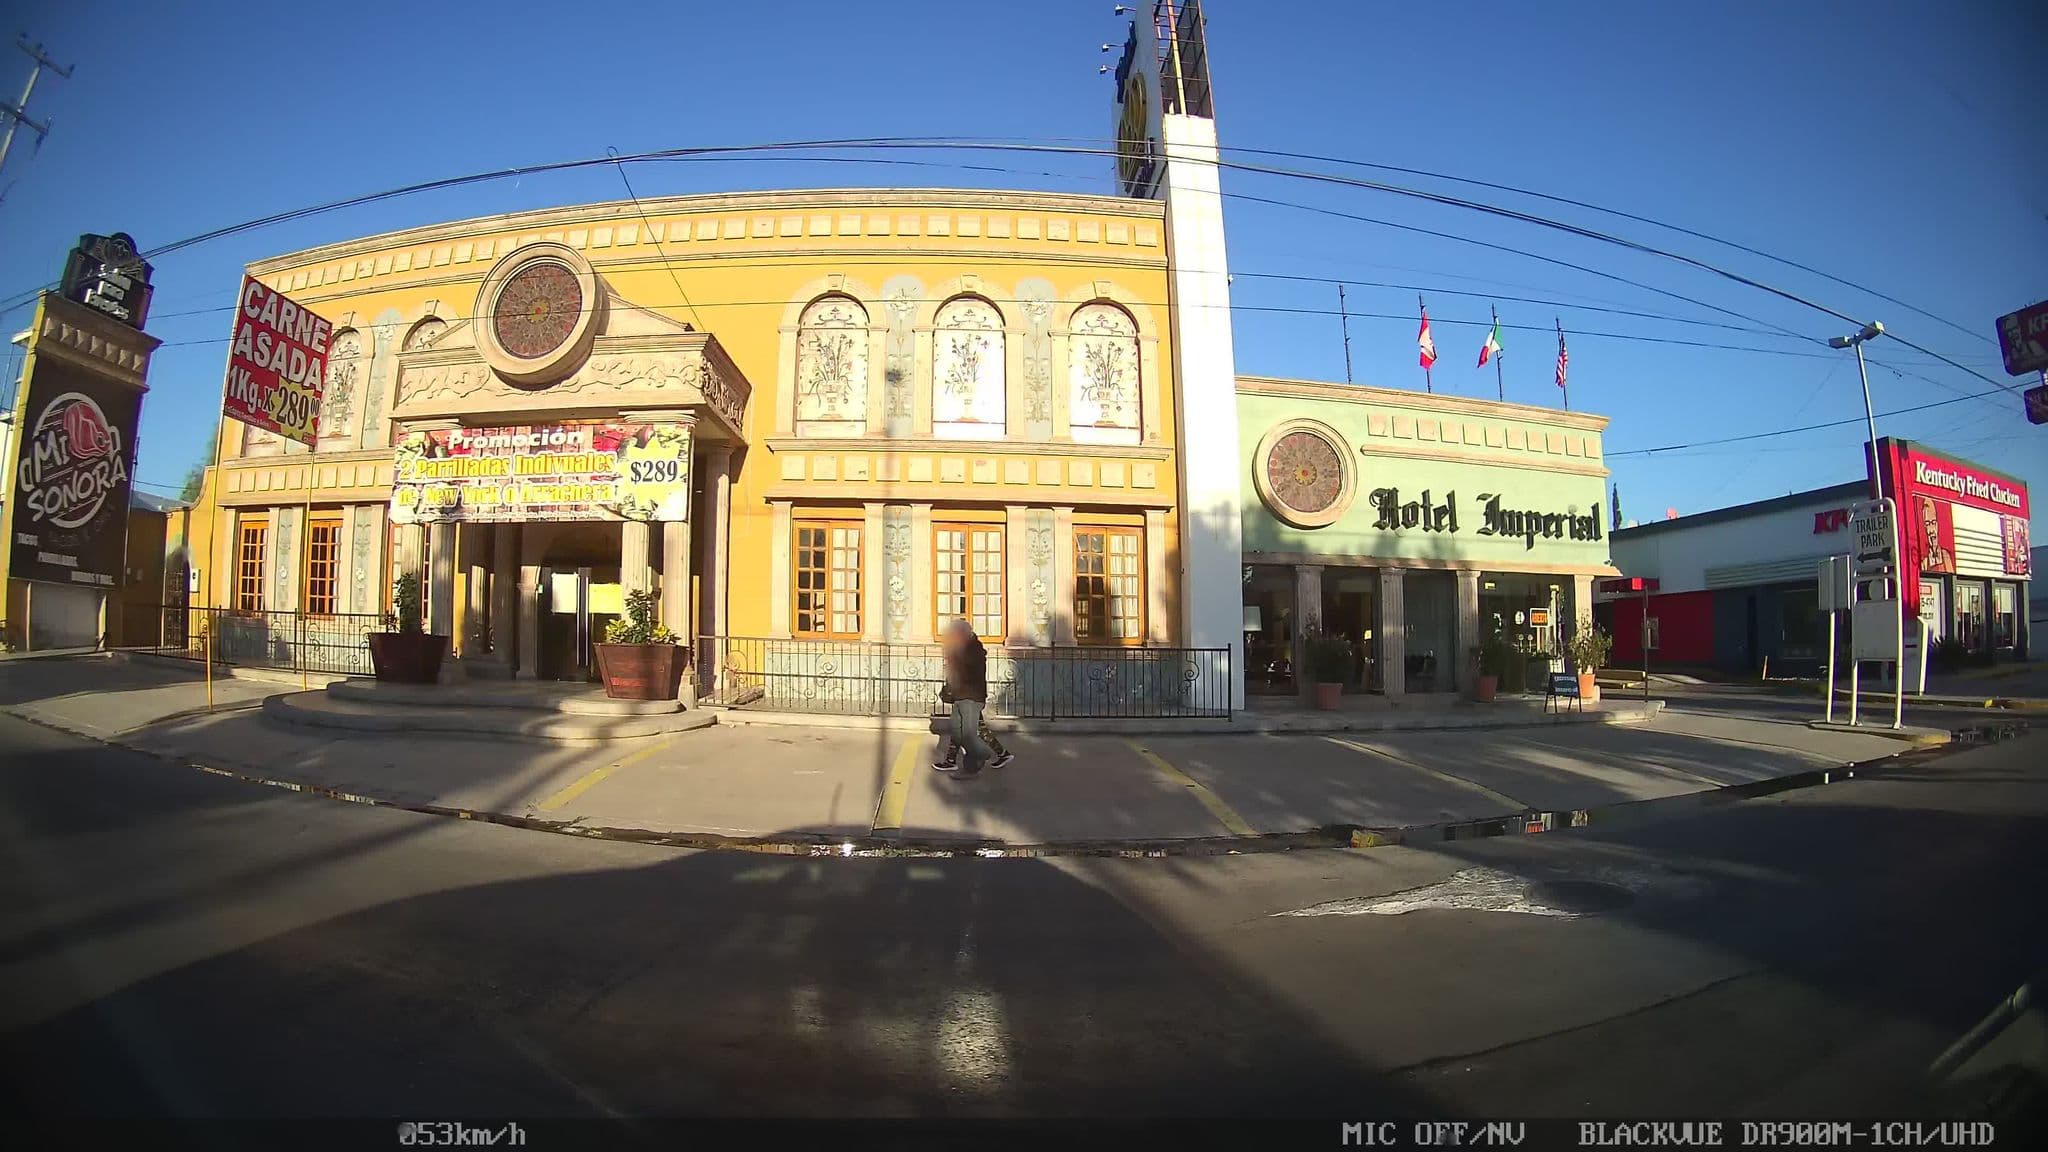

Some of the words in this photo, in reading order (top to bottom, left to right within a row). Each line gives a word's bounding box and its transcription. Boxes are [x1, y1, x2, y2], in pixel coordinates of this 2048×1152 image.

[244, 282, 330, 354] CARNE
[234, 322, 323, 392] ASADA
[229, 365, 262, 414] 1Kg.
[276, 386, 309, 430] 289
[448, 429, 585, 450] Promoción
[400, 459, 412, 479] 2
[415, 456, 510, 479] Parrilladas
[514, 452, 616, 475] Indivuales
[630, 460, 678, 484] $289
[1915, 460, 1965, 497] Kentucky
[1966, 475, 1989, 499] Fried
[1990, 483, 2020, 508] Chicken
[27, 455, 128, 522] SONORA
[424, 486, 459, 505] New
[462, 485, 500, 504] York
[1369, 487, 1459, 533] Hotel
[1476, 493, 1603, 551] Imperial
[1855, 515, 1888, 534] TRAILER
[1861, 532, 1885, 549] PARK
